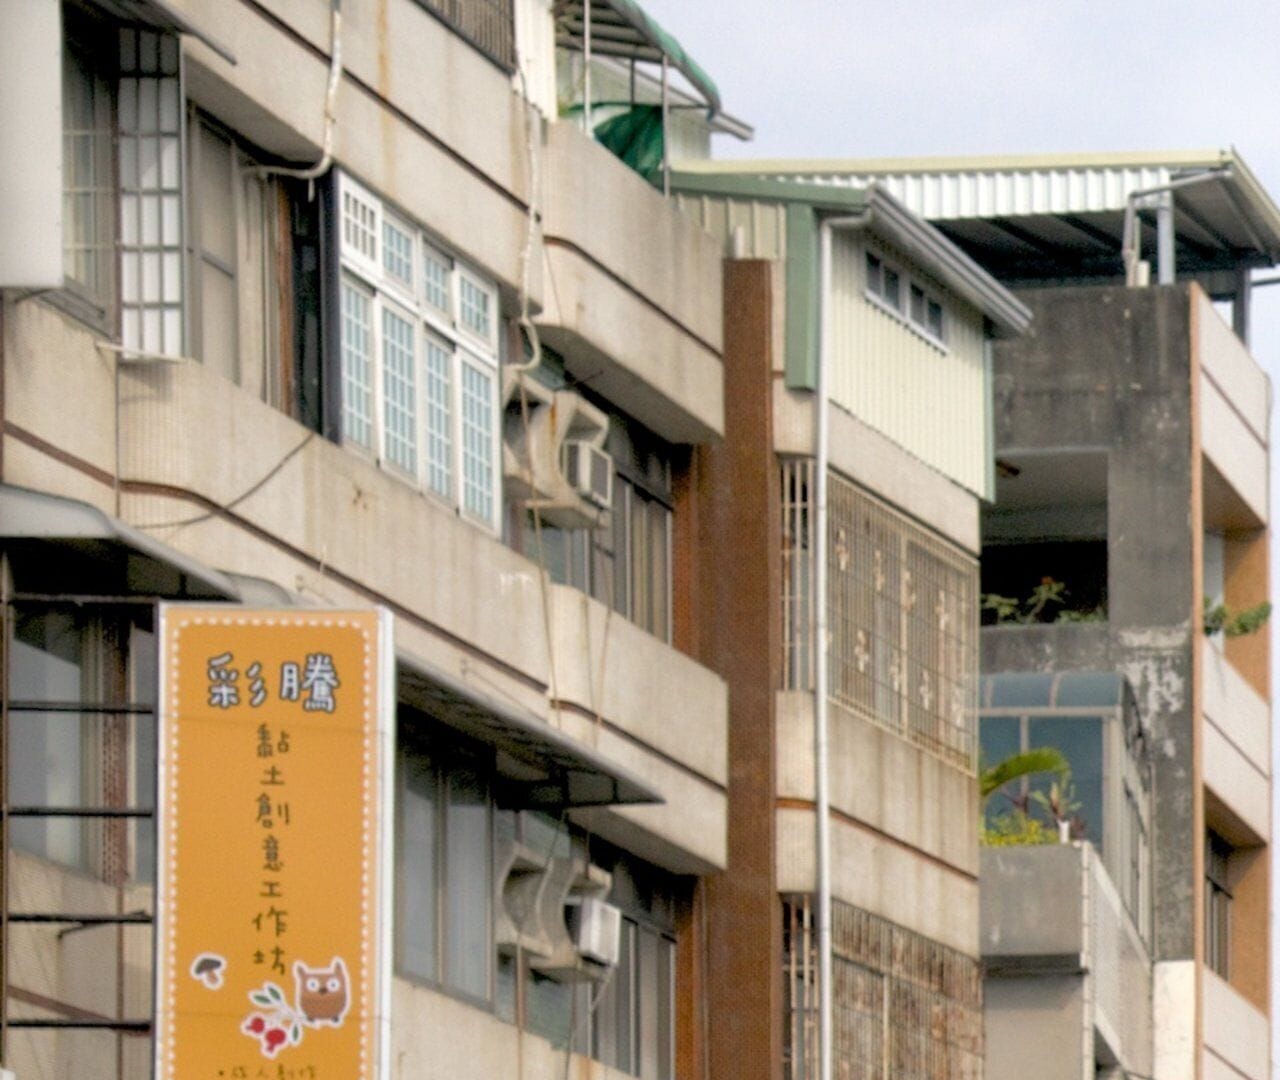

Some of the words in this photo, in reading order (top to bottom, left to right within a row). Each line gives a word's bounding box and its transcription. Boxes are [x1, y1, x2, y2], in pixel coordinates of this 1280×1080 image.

[208, 654, 341, 713] 彩騰
[256, 722, 290, 976] 黏土創意工作坊
